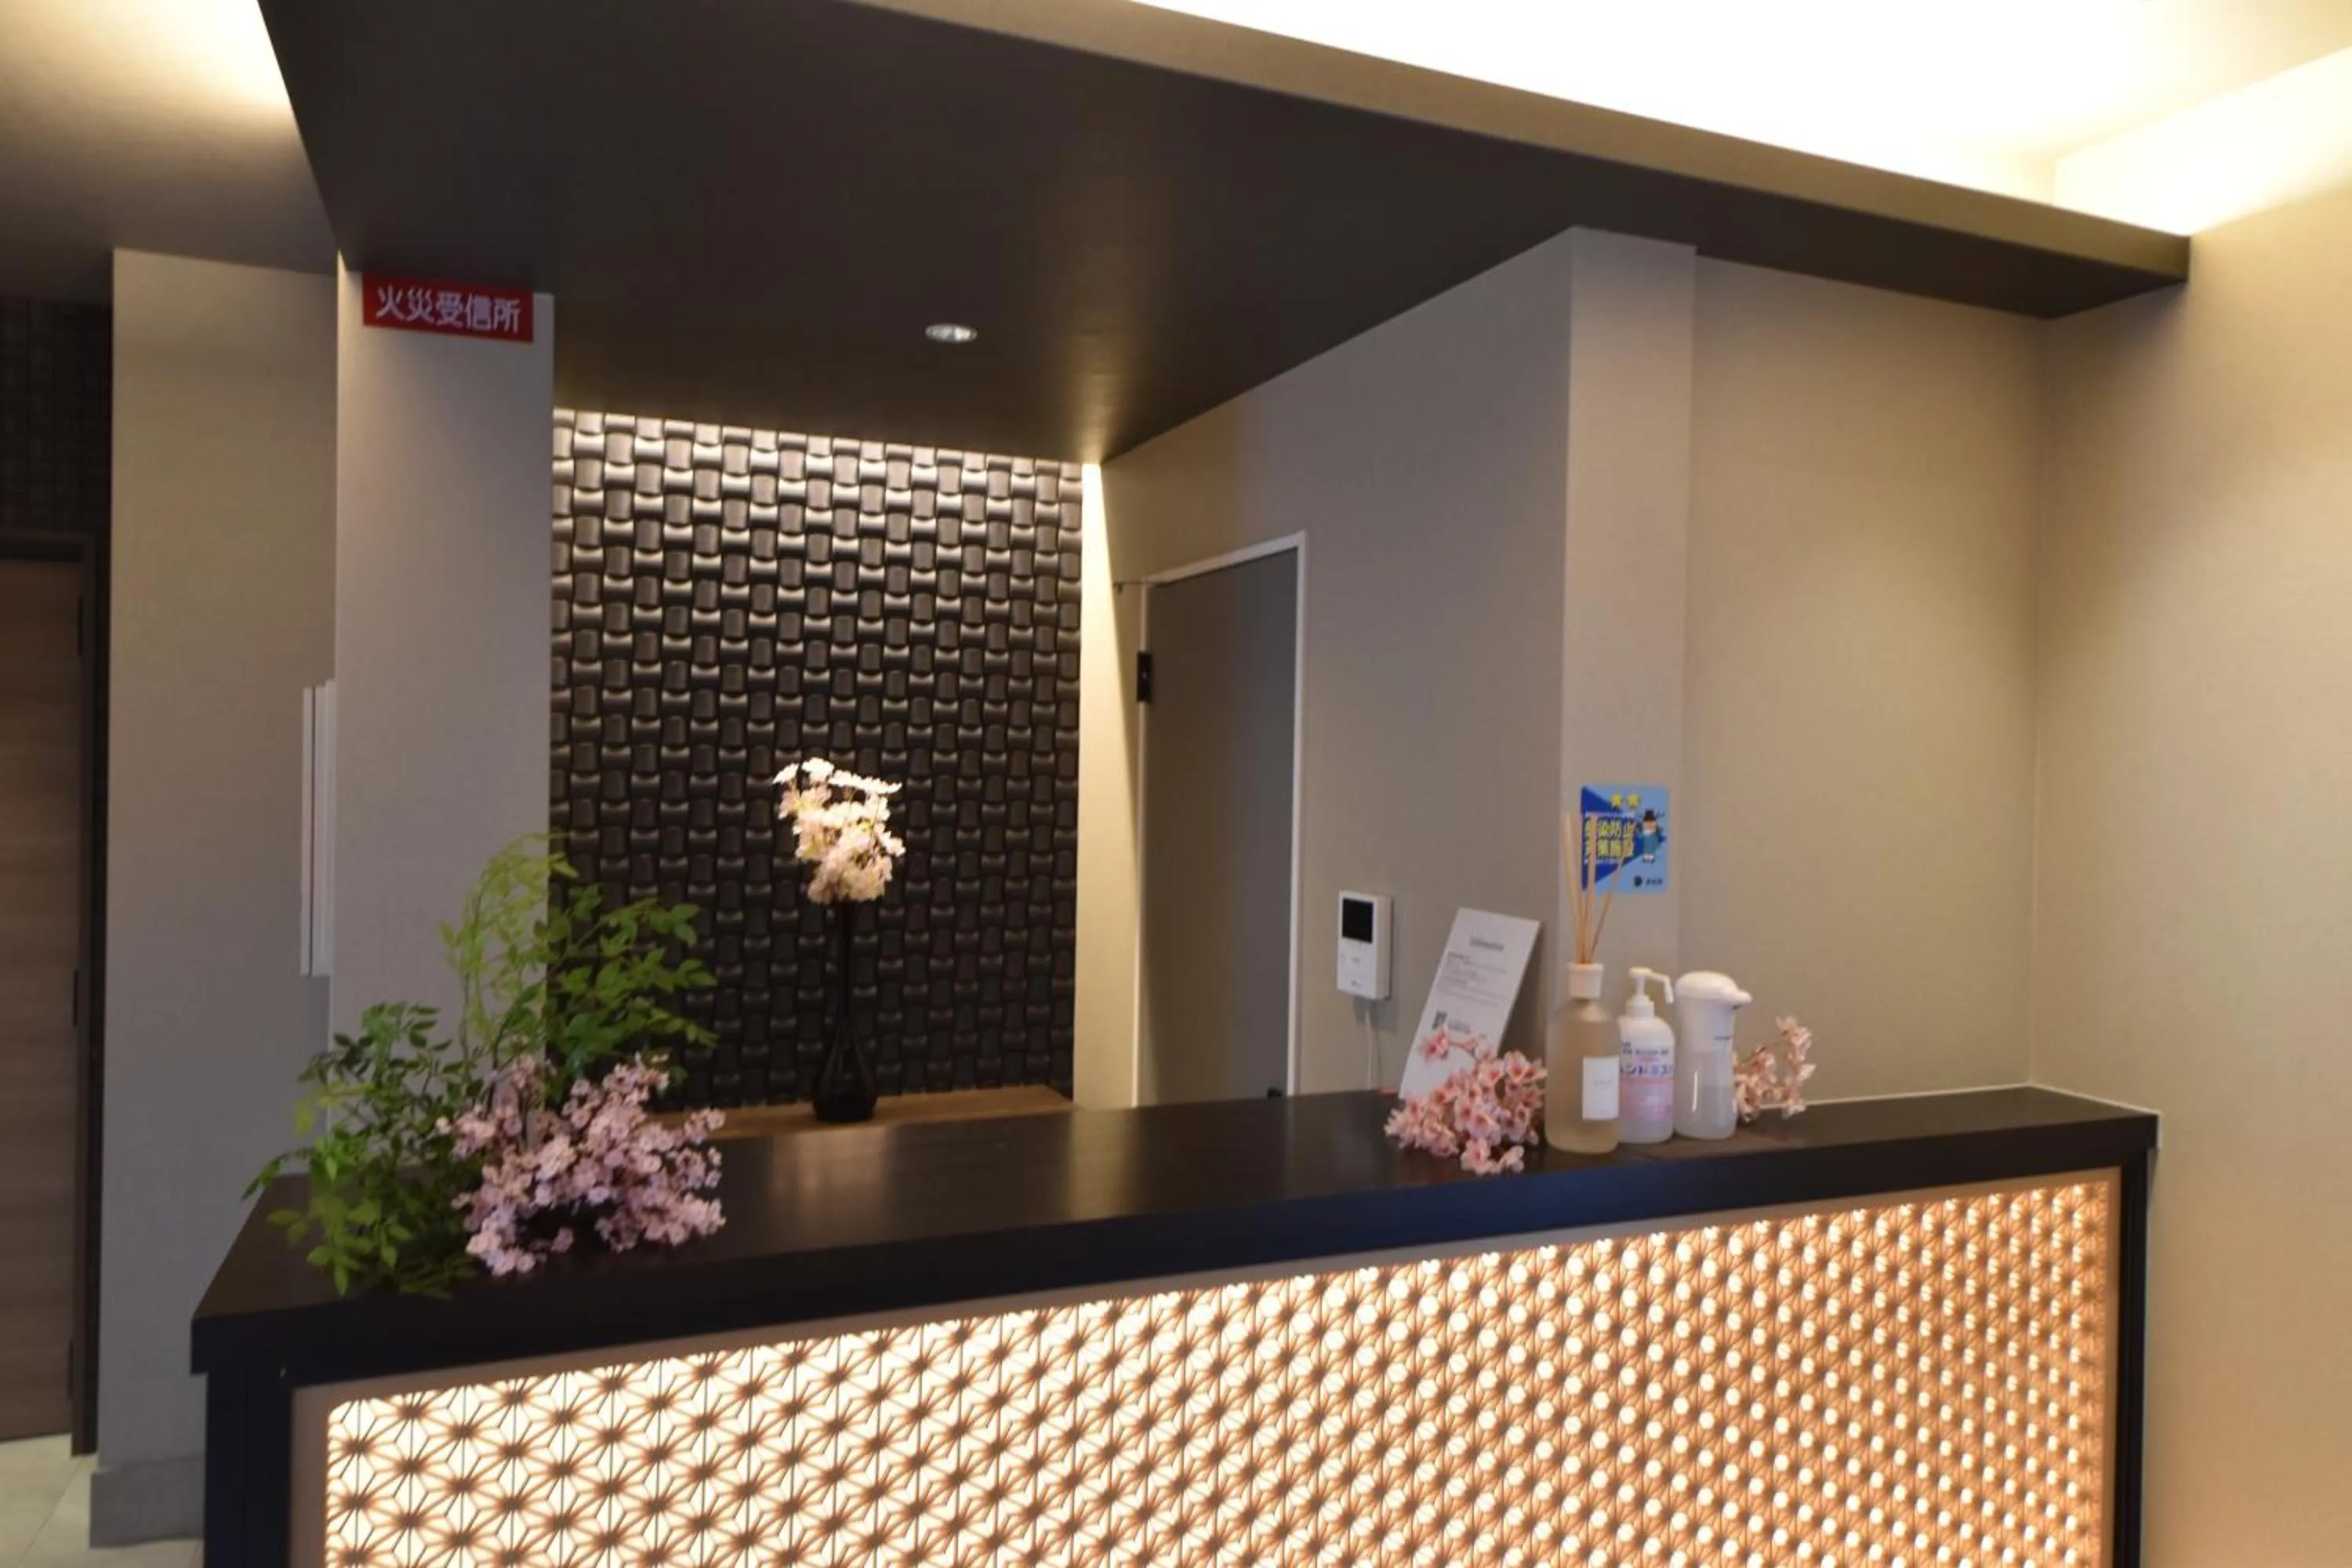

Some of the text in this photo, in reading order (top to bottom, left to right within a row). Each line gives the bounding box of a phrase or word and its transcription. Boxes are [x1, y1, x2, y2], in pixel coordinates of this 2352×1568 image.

[375, 284, 521, 333] 火災受信所
